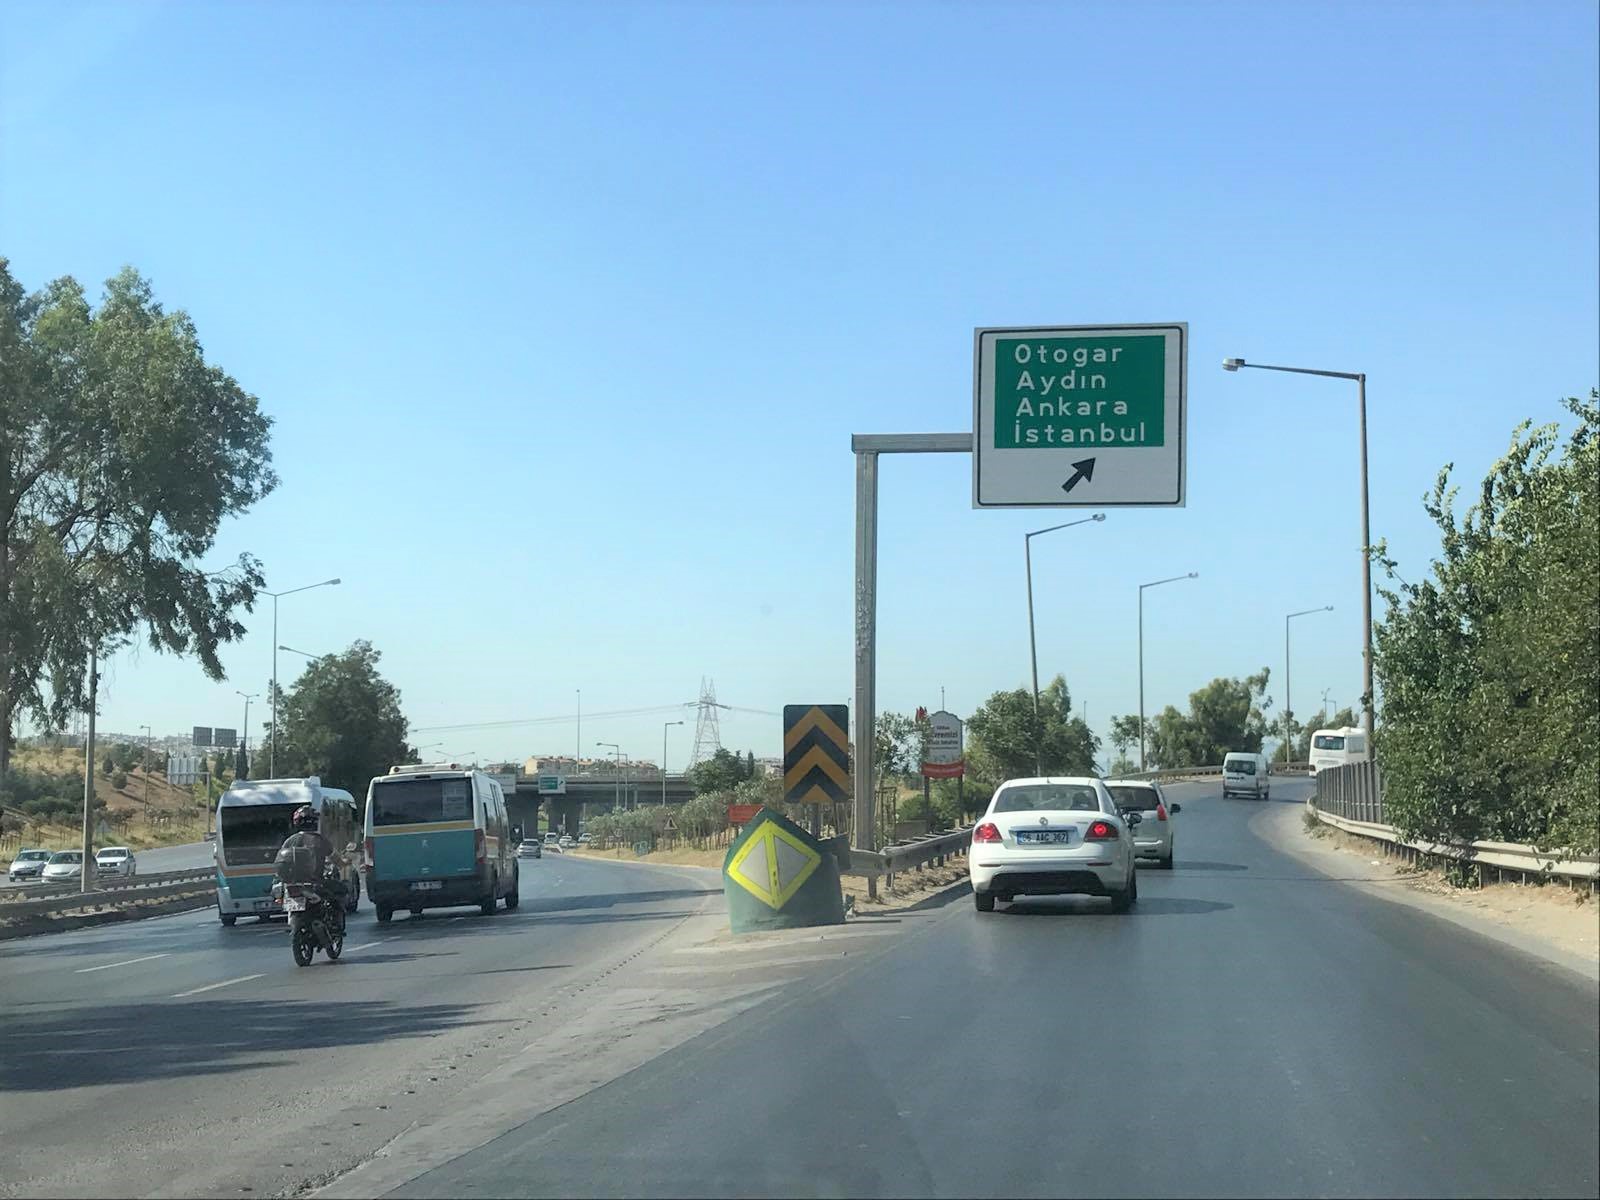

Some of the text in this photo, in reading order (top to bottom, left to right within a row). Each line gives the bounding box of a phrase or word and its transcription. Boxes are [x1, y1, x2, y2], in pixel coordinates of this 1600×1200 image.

[1014, 343, 1123, 368] Otogar
[1016, 370, 1107, 395] Aydın
[1015, 396, 1129, 417] Ankara
[1014, 419, 1146, 443] İstanbul
